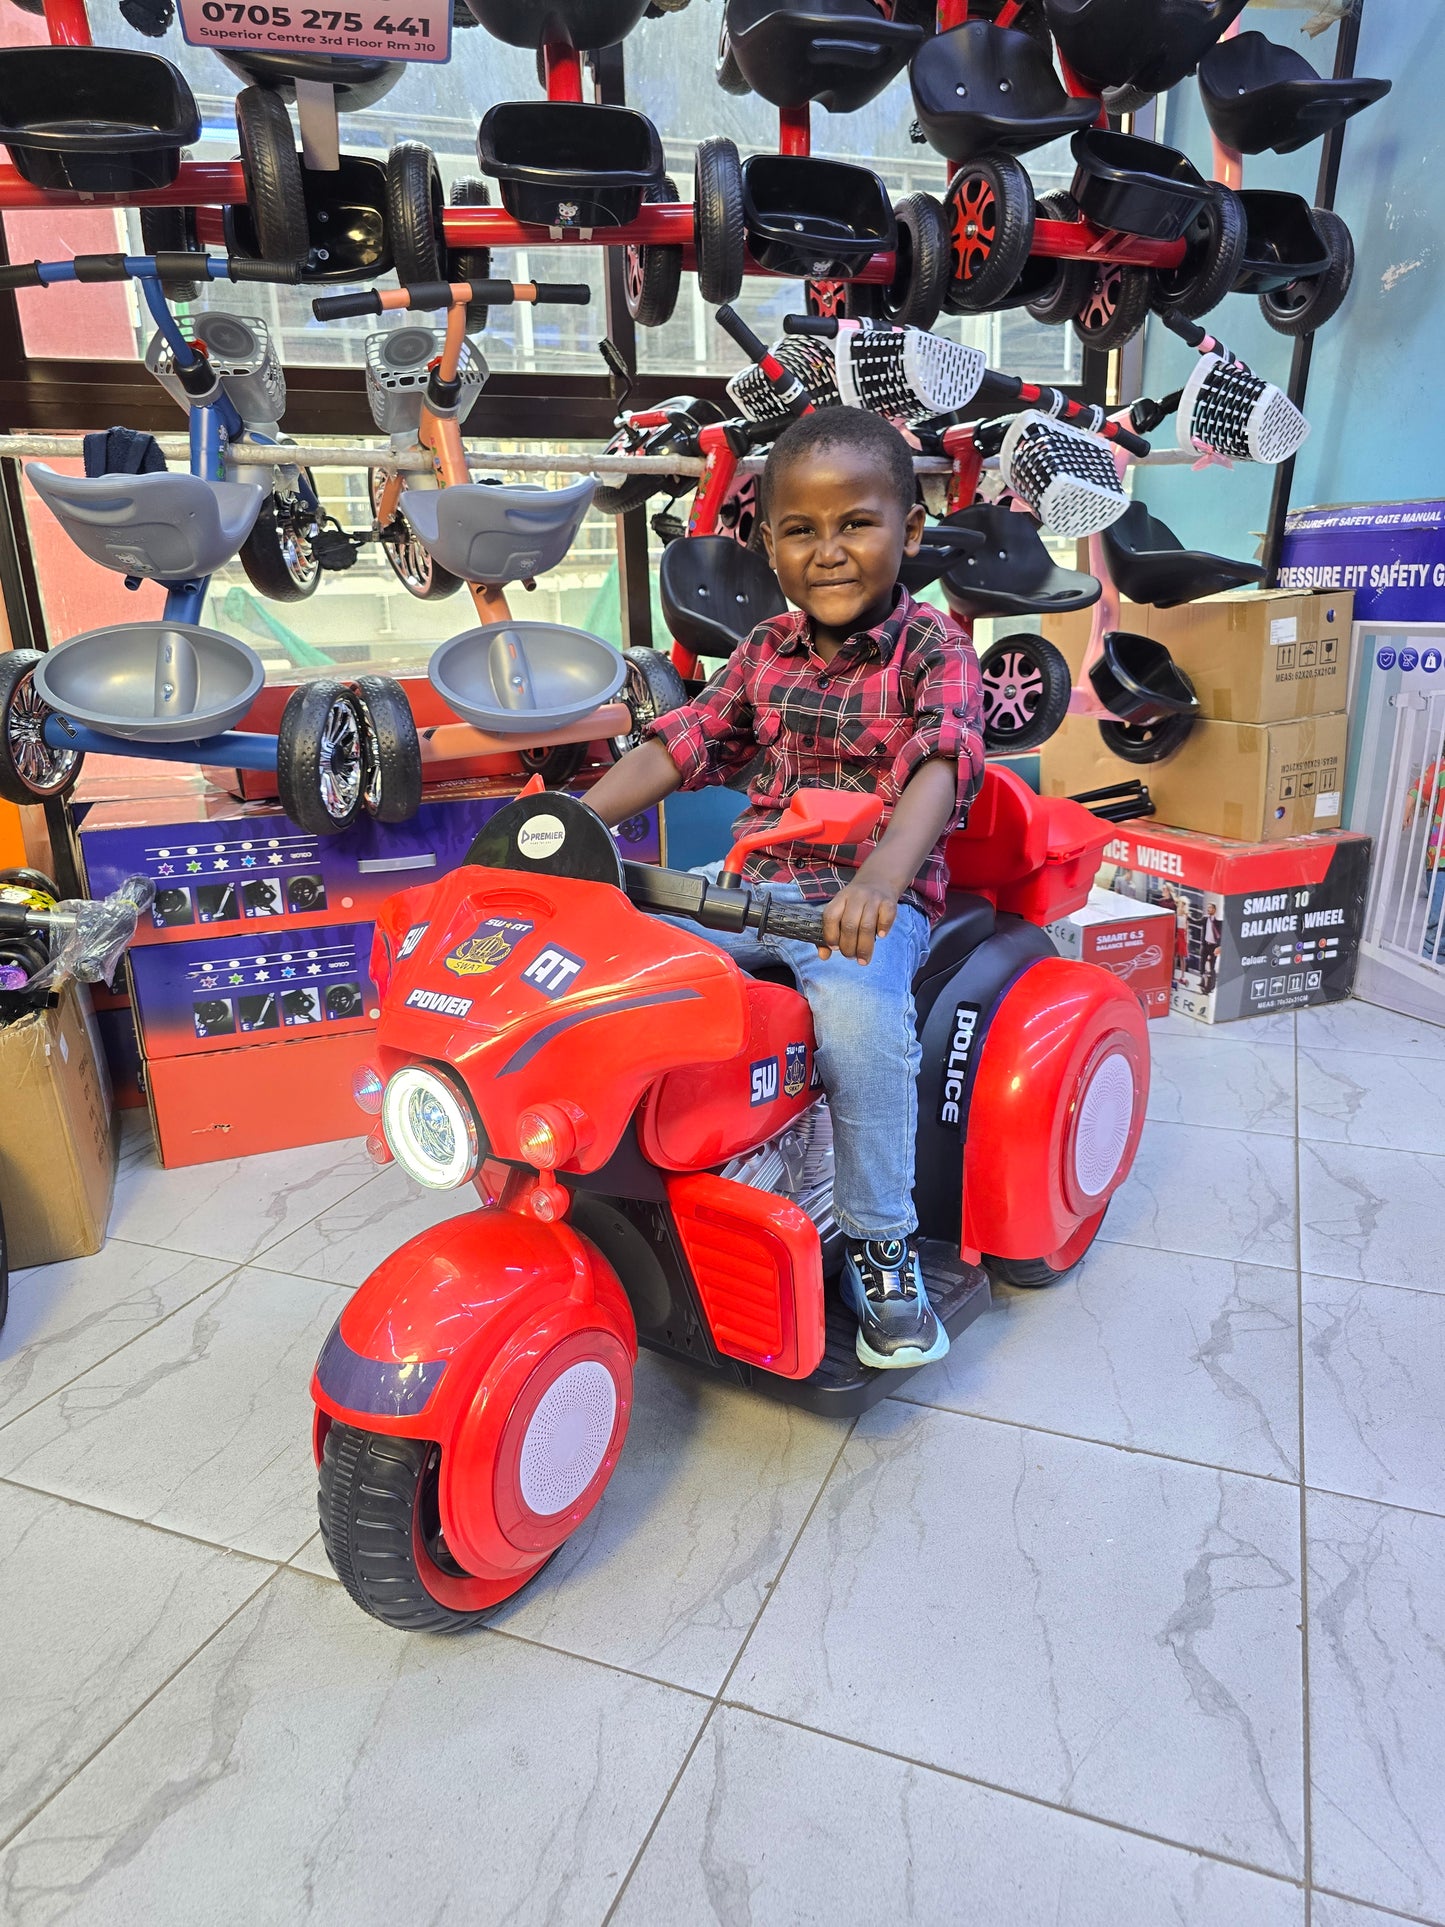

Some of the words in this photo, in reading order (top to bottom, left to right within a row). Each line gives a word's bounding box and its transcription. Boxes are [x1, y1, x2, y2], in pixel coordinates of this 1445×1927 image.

[202, 1, 291, 27] 0705
[301, 9, 362, 32] 275
[373, 15, 430, 37] 441
[200, 27, 263, 41] Superior
[267, 31, 315, 44] Centre
[320, 36, 343, 46] 3rd
[347, 37, 382, 49] Floor
[387, 41, 409, 51] Rm
[414, 43, 435, 52] J10
[1339, 515, 1375, 527] SAFETY
[1375, 514, 1400, 525] GATE
[1401, 511, 1441, 523] MANUAL
[1344, 565, 1367, 588] FIT
[1370, 563, 1430, 588] SAFETY
[1433, 563, 1445, 588] G
[530, 831, 563, 841] PREMIER
[1136, 844, 1185, 877] WHEEL
[1243, 894, 1286, 915] SMART
[1294, 891, 1309, 907] 10
[1241, 915, 1297, 938] BALANCE
[1305, 908, 1345, 929] WHEEL
[1096, 931, 1127, 944] SMART
[1130, 930, 1144, 939] 6.5
[1096, 942, 1123, 951] BALANCE
[453, 961, 483, 972] SWAT
[523, 949, 581, 991] AT
[1241, 955, 1267, 966] Colour:
[406, 989, 473, 1017] POWER
[942, 1009, 977, 1123] POLICE
[751, 1063, 777, 1102] SW
